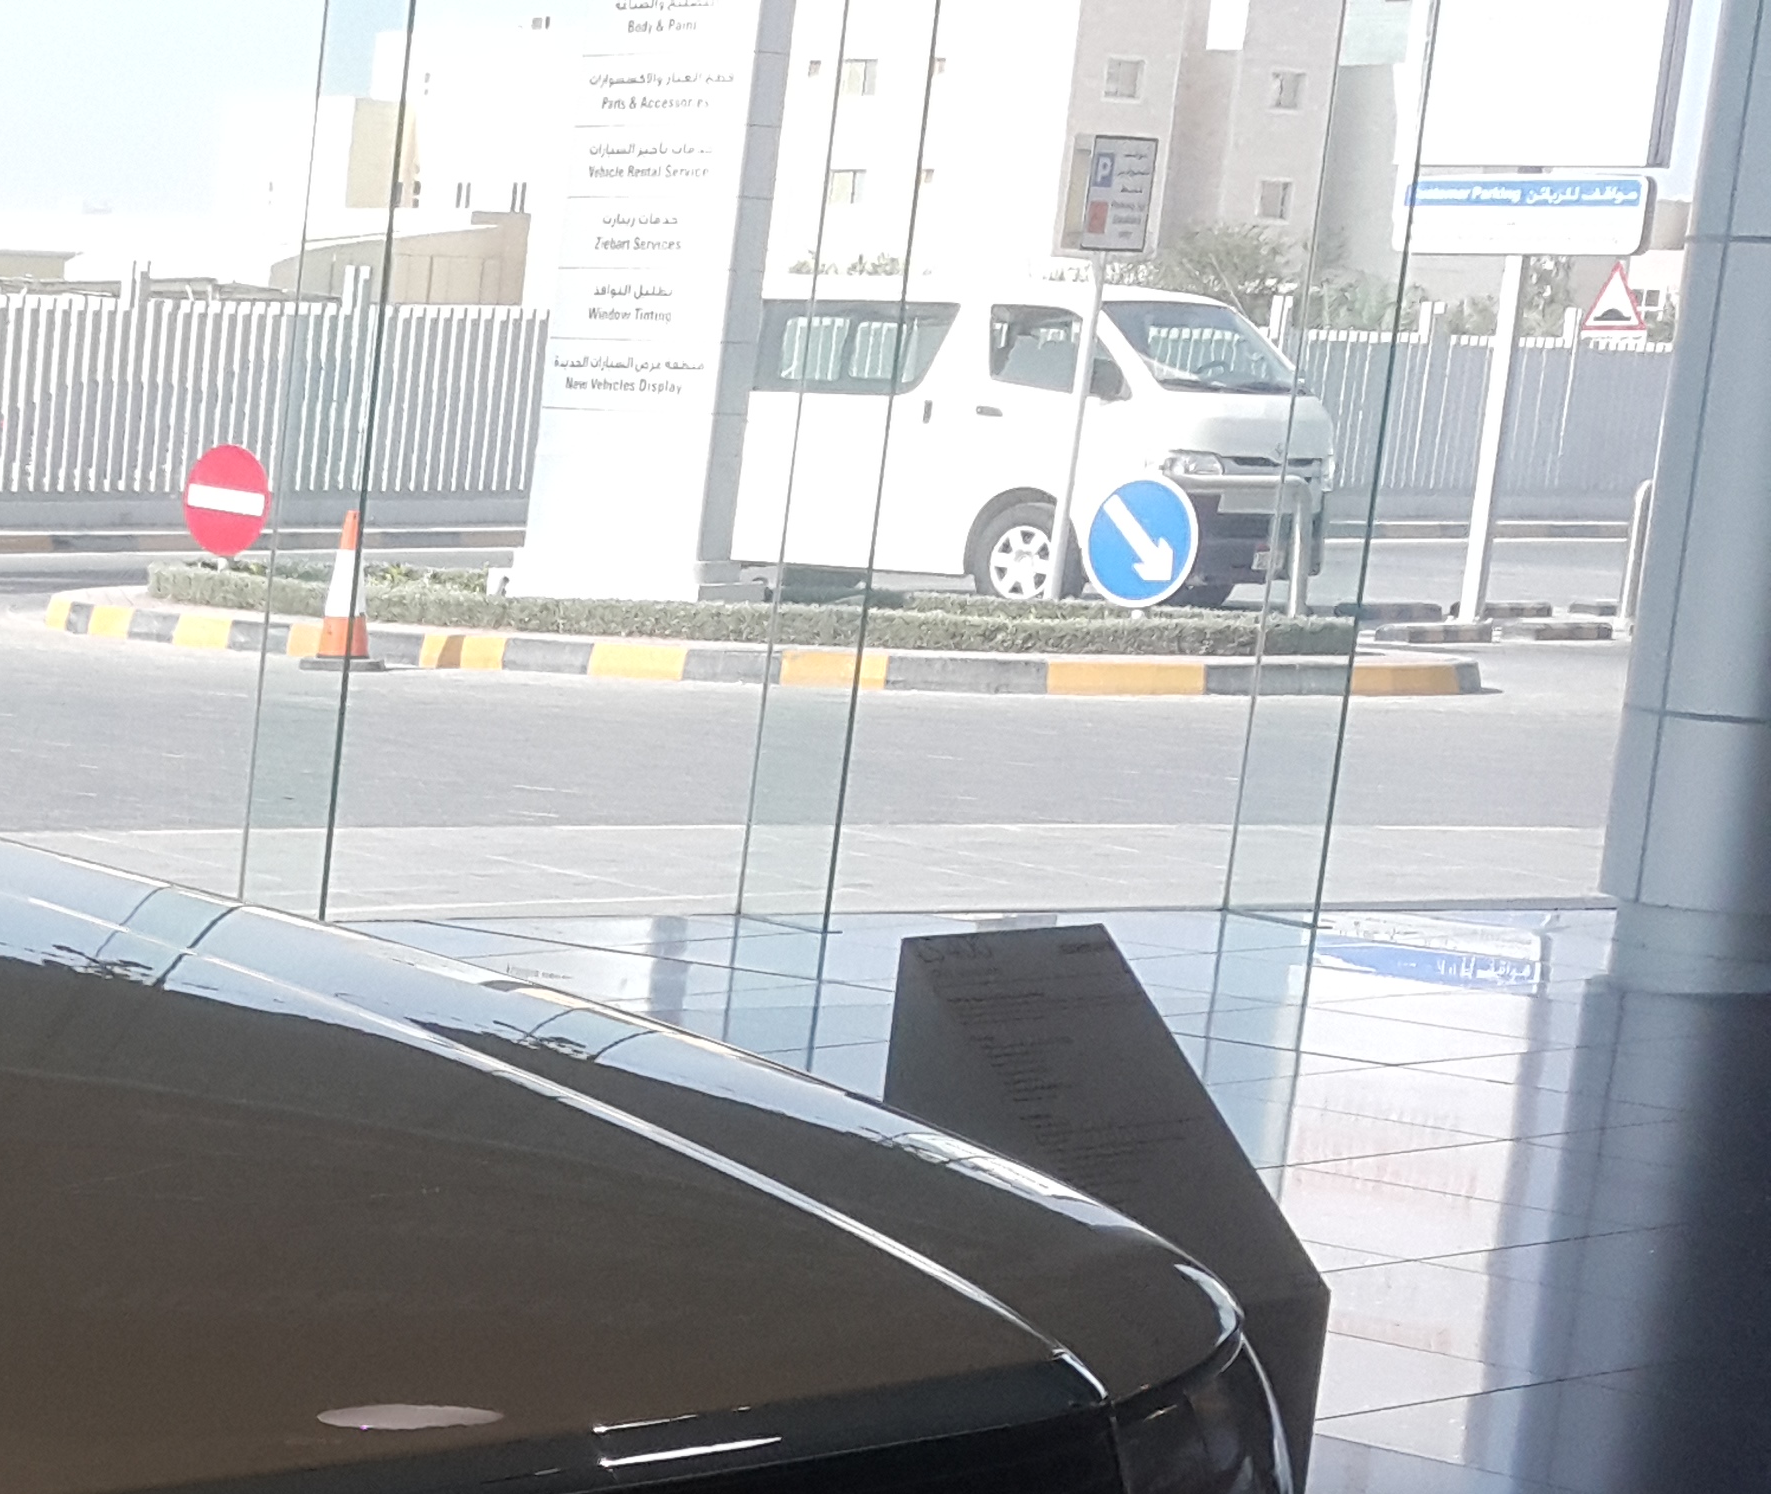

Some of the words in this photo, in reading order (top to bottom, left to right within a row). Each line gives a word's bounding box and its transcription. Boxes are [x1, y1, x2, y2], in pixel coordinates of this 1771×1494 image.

[627, 19, 653, 34] Body
[656, 19, 664, 33] &
[600, 96, 626, 110] Parts
[629, 96, 637, 110] &
[640, 96, 709, 110] Accessores
[589, 165, 624, 178] Vehicle
[627, 165, 661, 178] Rental
[1416, 187, 1471, 200] ustomer
[1472, 186, 1522, 204] Parking
[633, 236, 682, 250] Services
[588, 307, 631, 321] Window
[634, 308, 671, 324] Tinting
[565, 376, 588, 390] New
[591, 377, 635, 391] Vehicles
[639, 379, 682, 394] Display
